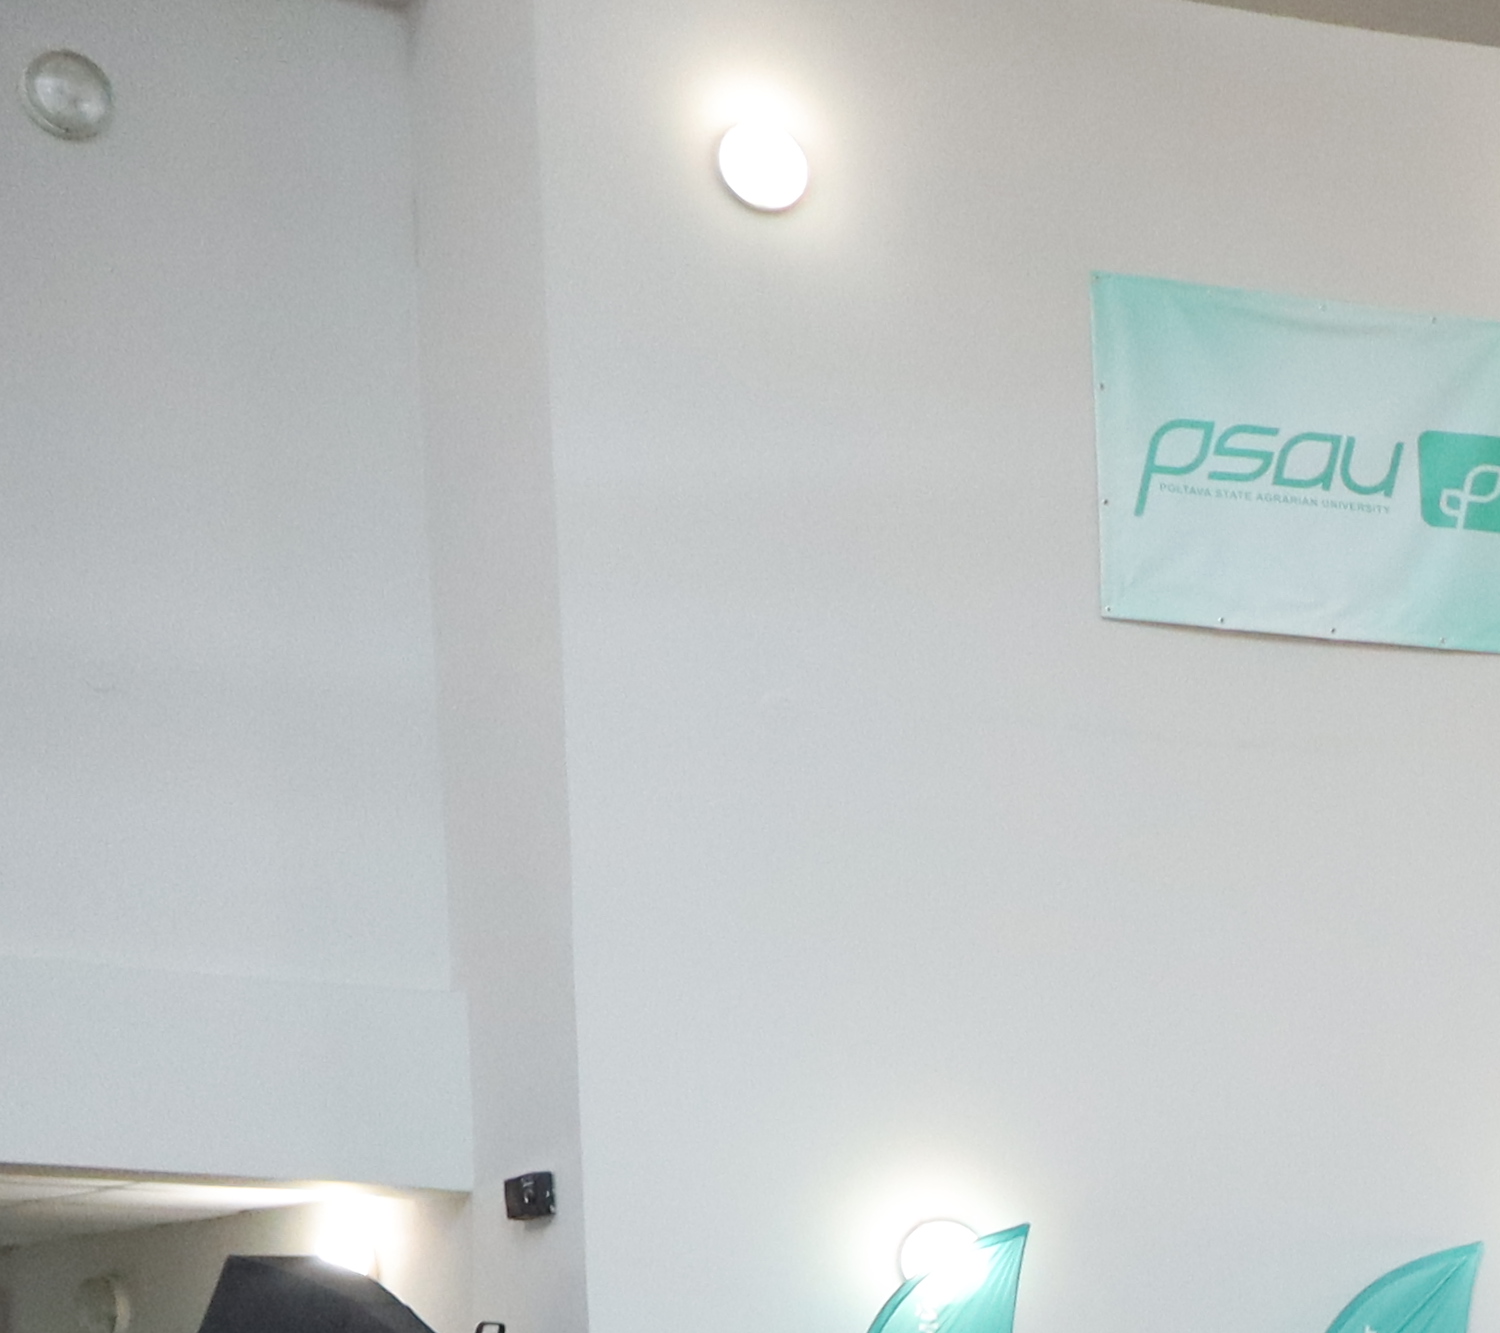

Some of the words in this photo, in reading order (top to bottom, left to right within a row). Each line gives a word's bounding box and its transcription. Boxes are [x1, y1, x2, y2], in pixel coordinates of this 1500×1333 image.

[1134, 418, 1405, 517] psau
[1159, 482, 1212, 498] POLTAVA
[1215, 488, 1250, 501] STATE
[1255, 492, 1318, 507] AGRARIAN
[1321, 499, 1391, 515] UNIVERSITY
